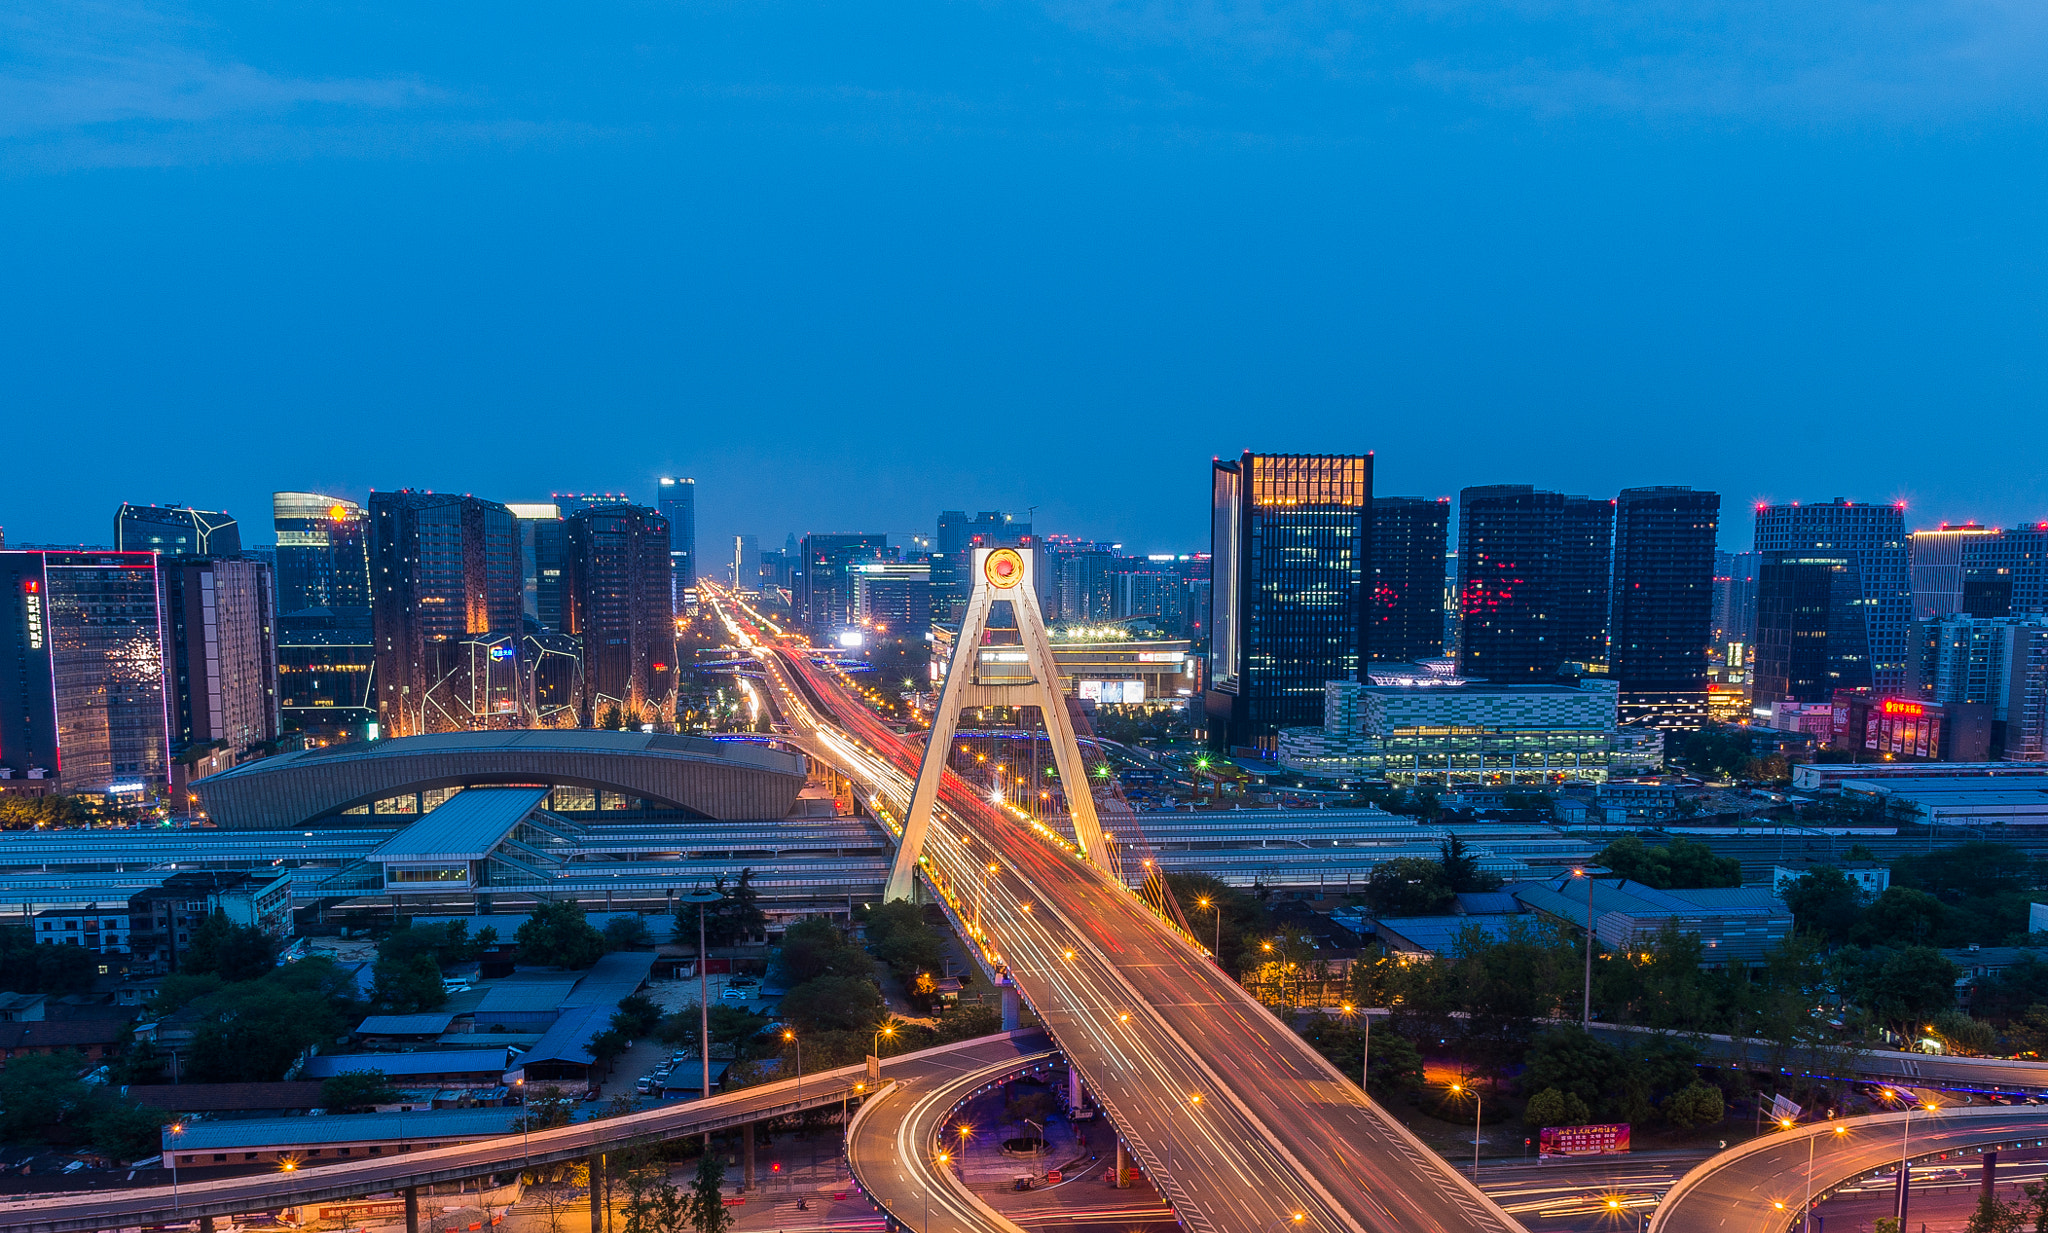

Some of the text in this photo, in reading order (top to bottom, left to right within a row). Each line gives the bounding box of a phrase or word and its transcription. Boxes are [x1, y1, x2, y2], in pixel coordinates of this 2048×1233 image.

[1558, 1127, 1618, 1135] 社会主义核心价值观
